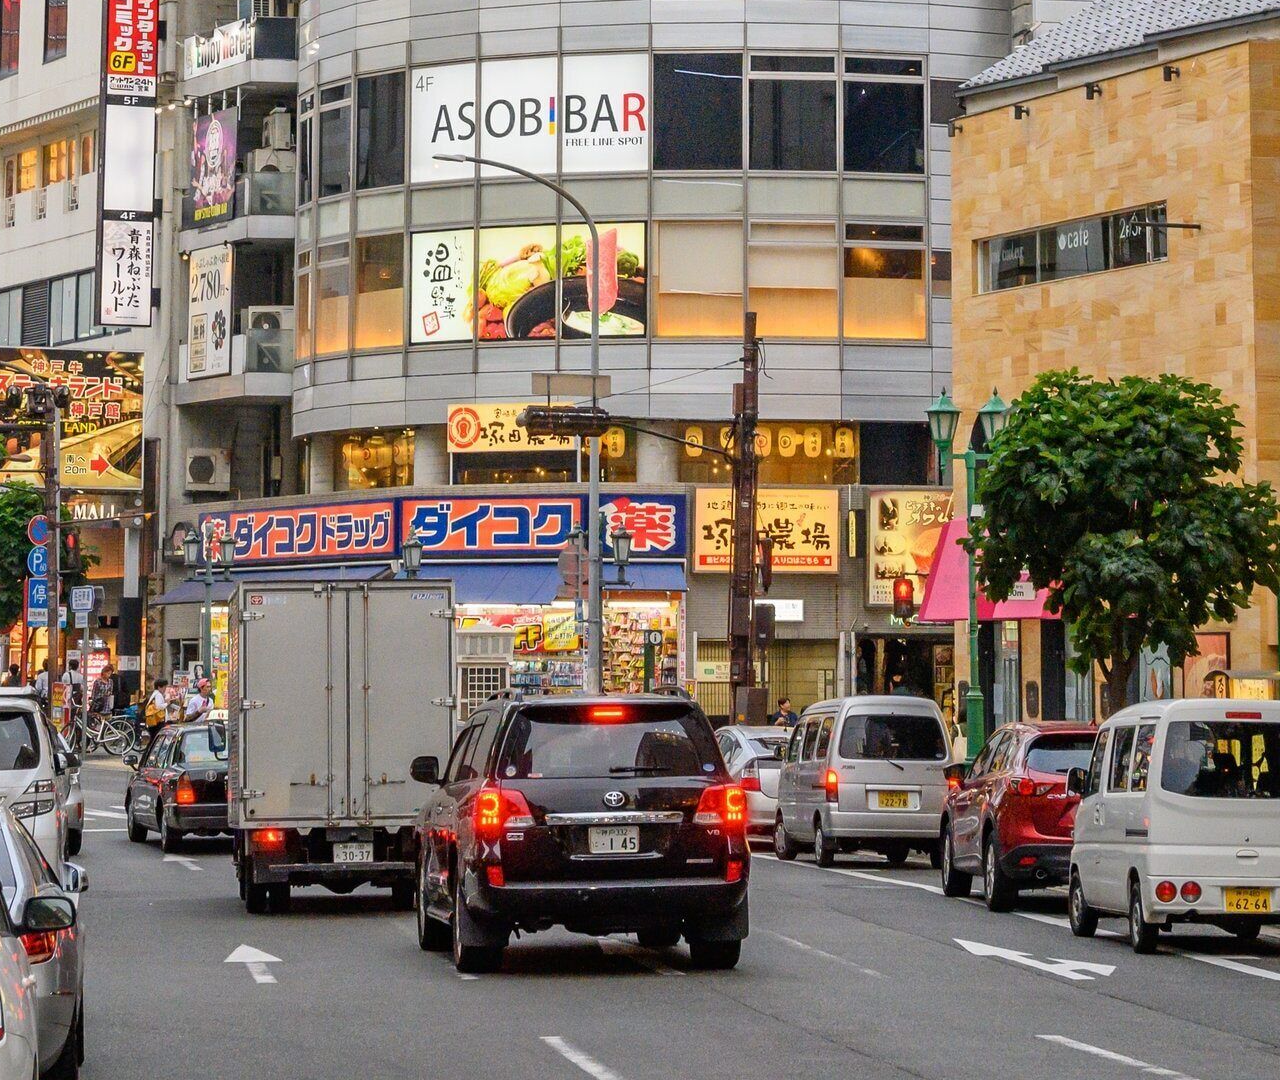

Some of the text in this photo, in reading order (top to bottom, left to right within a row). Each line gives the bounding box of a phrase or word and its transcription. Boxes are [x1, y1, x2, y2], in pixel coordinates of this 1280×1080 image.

[112, 53, 134, 69] 6F
[134, 77, 153, 86] 24h
[415, 75, 434, 92] 4F
[123, 96, 139, 106] 5F
[565, 137, 644, 147] FREE LINE SPOT
[120, 211, 136, 221] 4F
[126, 228, 142, 308] 青森ねぶた
[111, 246, 126, 313] ワールド
[32, 359, 83, 374] 神戸牛
[70, 403, 120, 418] 神戸館
[64, 422, 98, 433] LAND
[66, 454, 86, 464] 南へ
[64, 465, 87, 475] 20m
[234, 508, 392, 556] ダイコクドラッグ
[413, 503, 573, 548] ダイコク
[611, 502, 676, 549] 薬
[32, 553, 43, 572] P
[884, 797, 908, 808] 22-78
[342, 850, 371, 862] 30-37
[1235, 898, 1268, 911] 62-64
